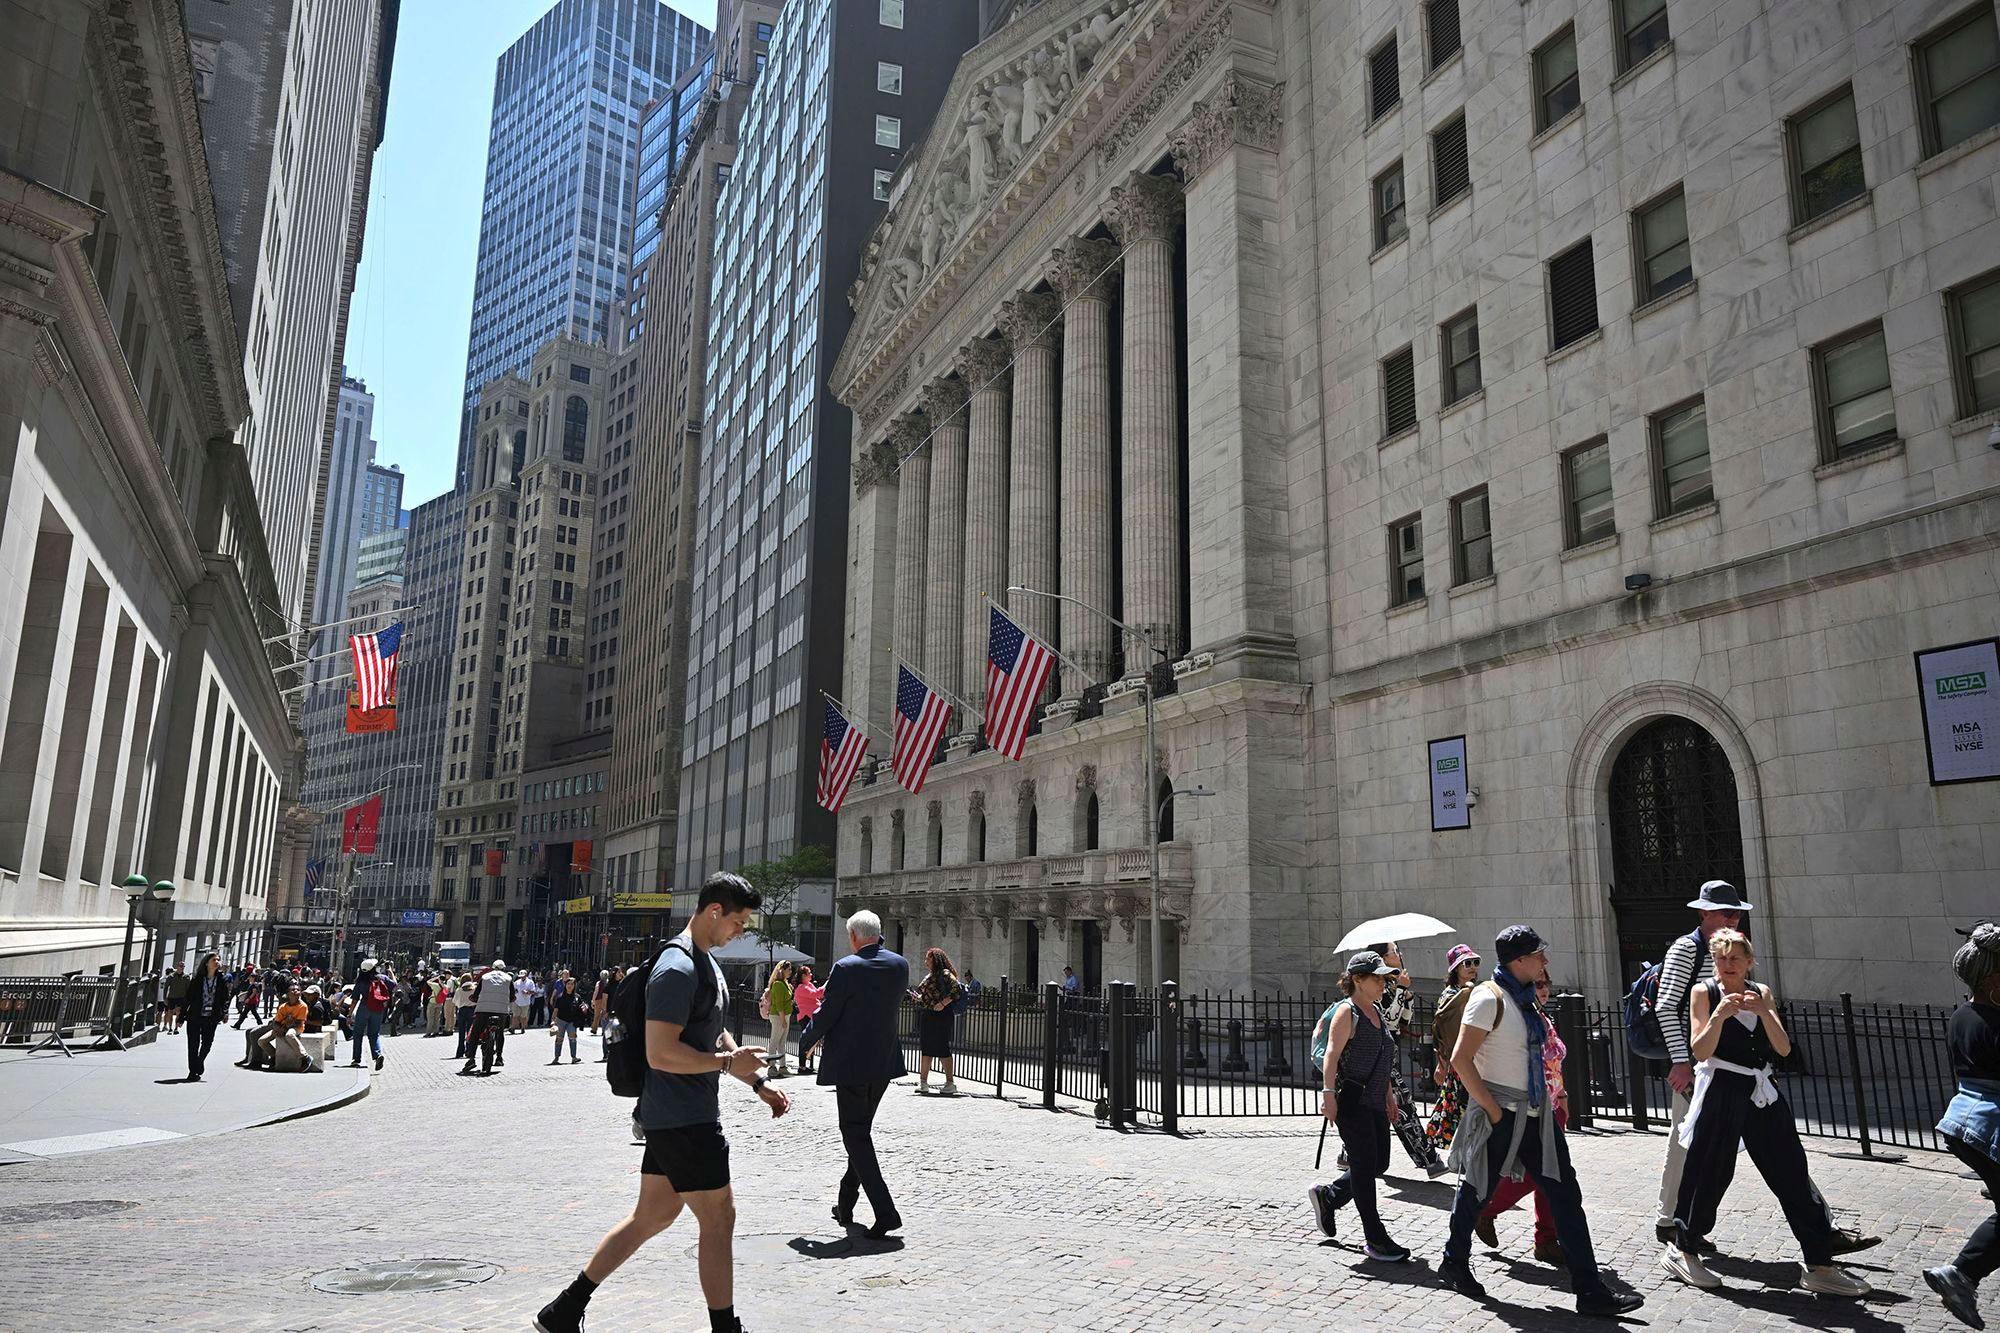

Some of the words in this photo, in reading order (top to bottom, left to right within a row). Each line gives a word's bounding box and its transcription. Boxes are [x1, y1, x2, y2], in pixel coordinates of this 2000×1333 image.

[1940, 675, 1984, 692] MSA
[1952, 722, 1981, 734] MSA
[1953, 733, 1983, 742] LISTED
[1954, 741, 1984, 752] NYSE
[1438, 758, 1458, 769] MSA
[51, 991, 88, 1000] Sttion
